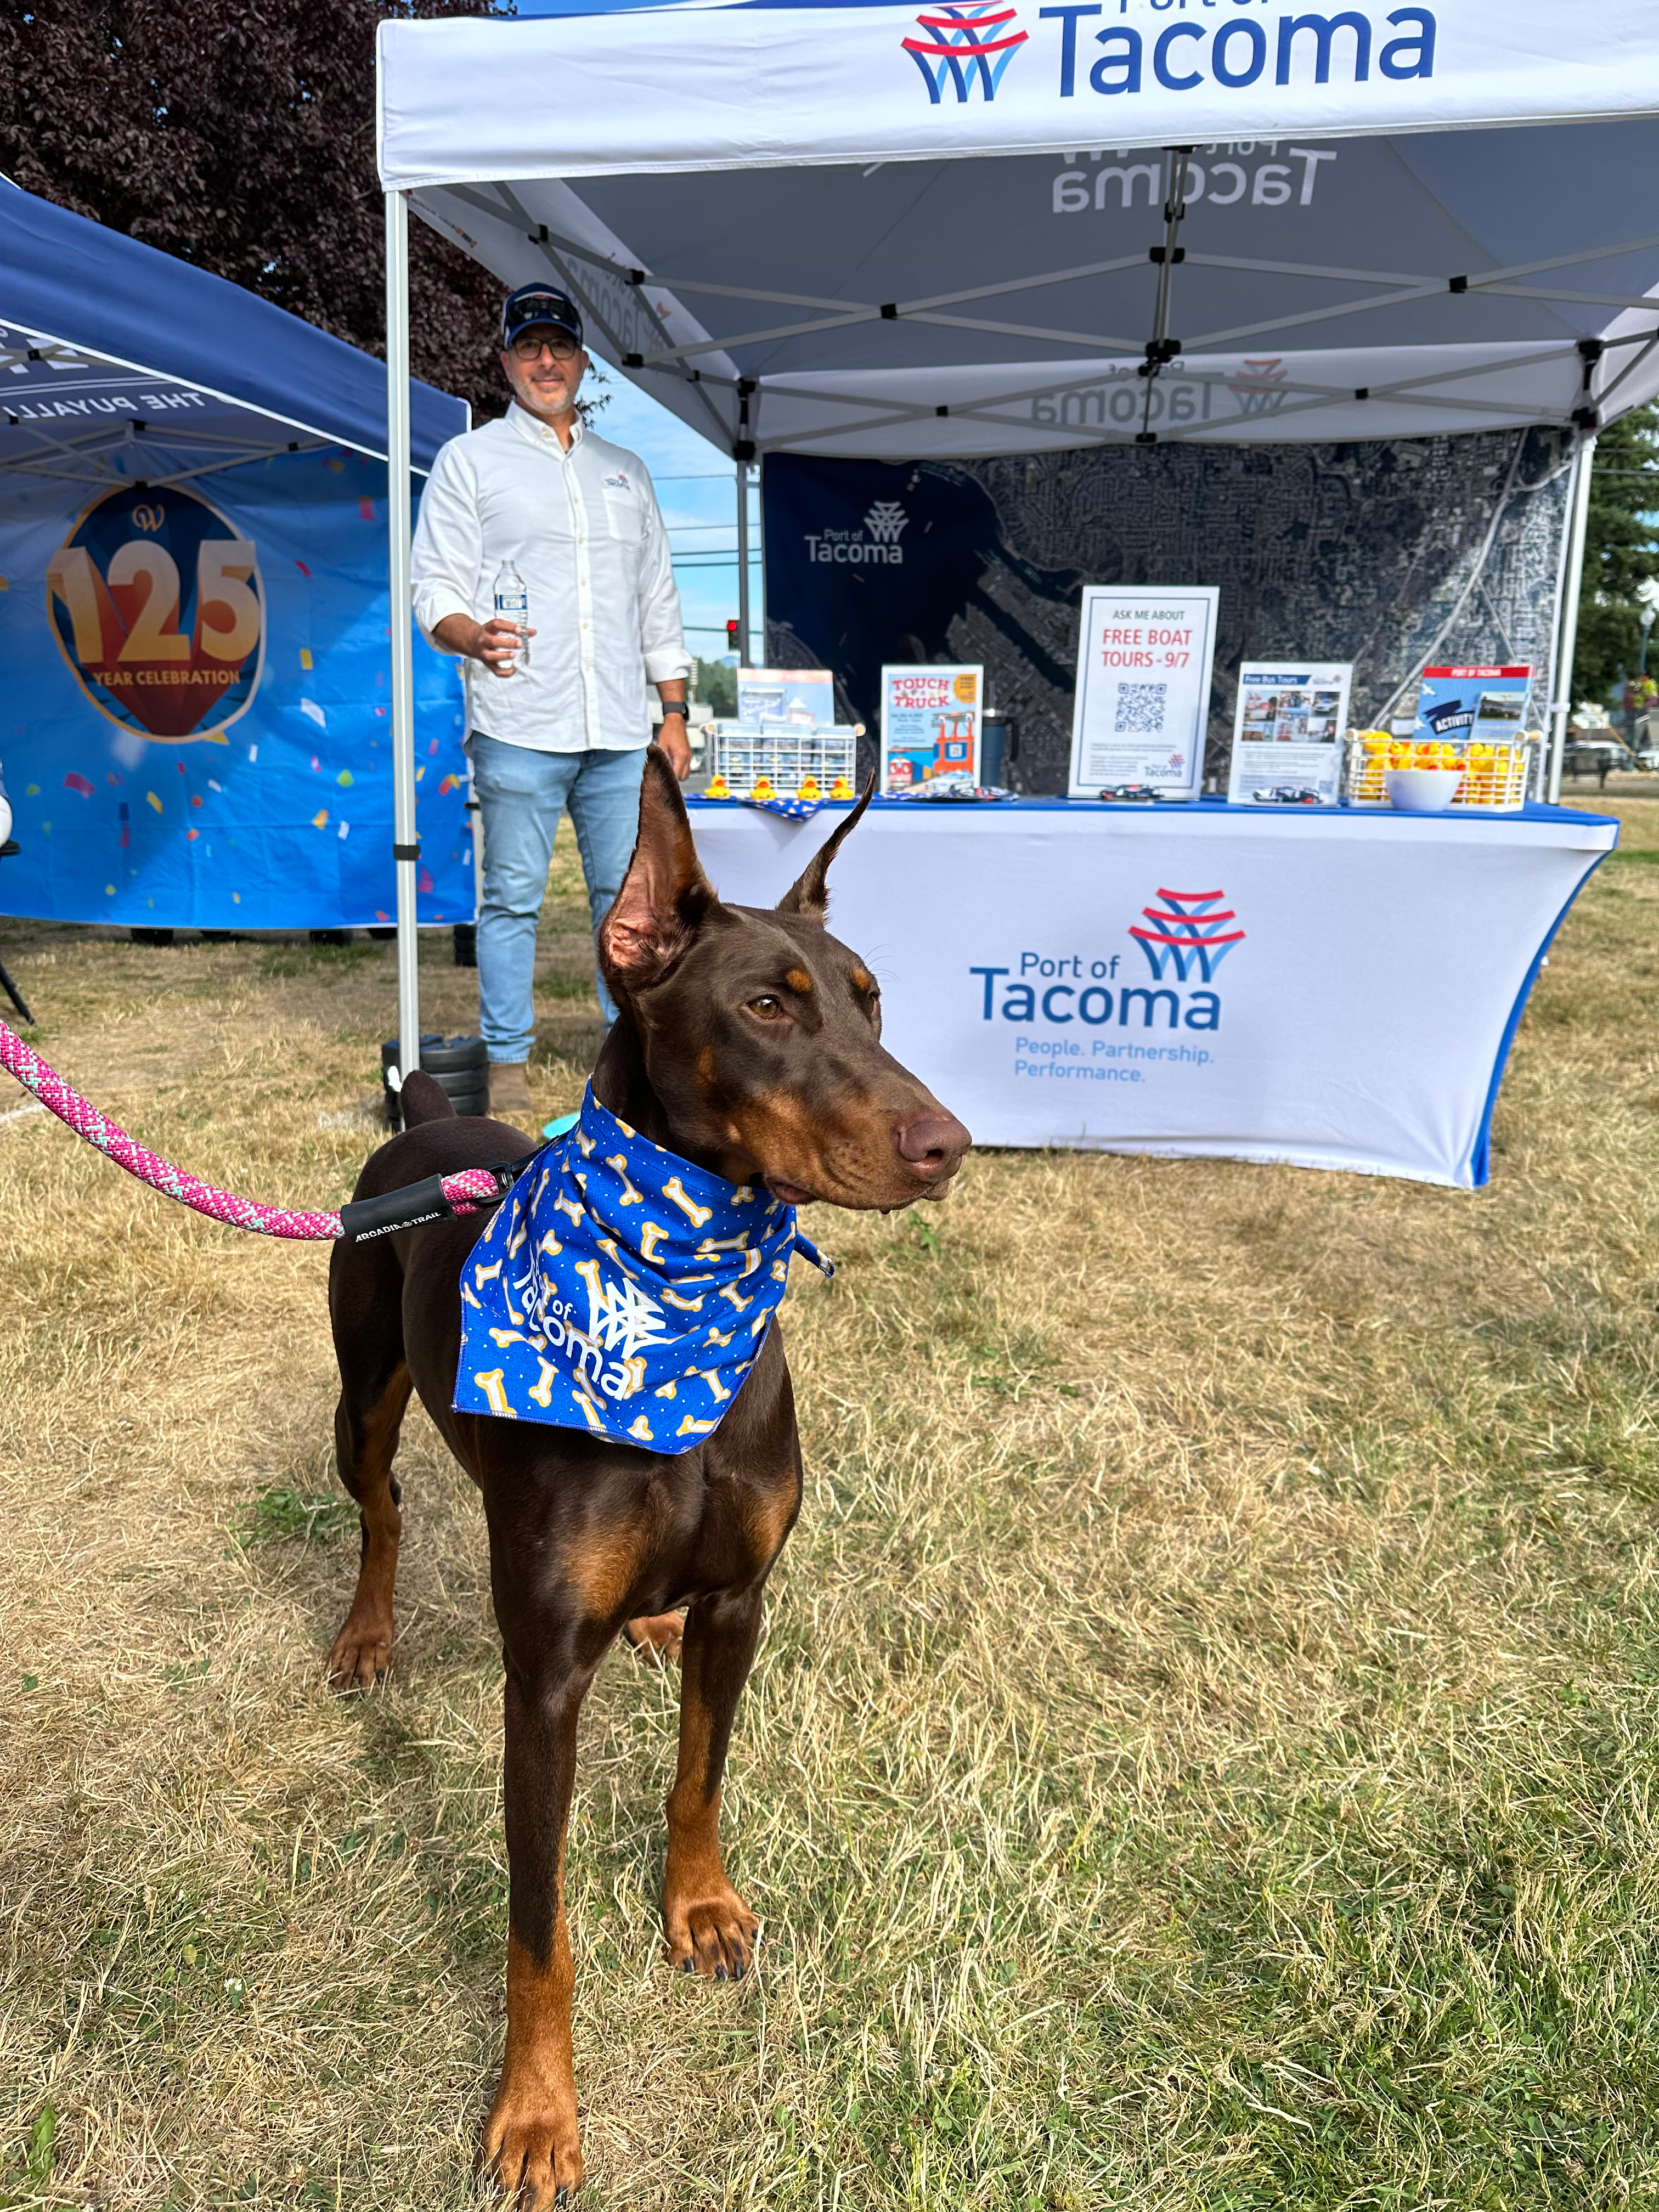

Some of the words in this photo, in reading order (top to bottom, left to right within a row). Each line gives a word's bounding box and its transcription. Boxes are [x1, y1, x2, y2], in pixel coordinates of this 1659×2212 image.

[1039, 4, 1437, 97] Tacoma
[823, 528, 850, 541] Port
[851, 529, 864, 541] of
[804, 535, 904, 564] Tacoma
[46, 540, 261, 664] 125
[1112, 610, 1132, 620] ASK
[1135, 610, 1150, 620] ME
[1151, 610, 1185, 620] ABOUT
[1102, 629, 1142, 645] FREE
[1148, 629, 1193, 646] BOAT
[93, 672, 134, 686] YEAR
[137, 669, 240, 685] CELEBRATION
[892, 677, 950, 691] TOUCH
[1245, 675, 1261, 684] Free
[1262, 675, 1276, 684] Bus
[1278, 675, 1298, 685] Tours
[894, 695, 951, 708] TRUCK
[1144, 766, 1182, 778] Tacoma
[1020, 952, 1082, 978] Port
[1091, 955, 1121, 979] of
[969, 967, 1221, 1031] Tacoma
[1015, 1036, 1085, 1058] People.
[1092, 1040, 1214, 1066] Partnership.
[1015, 1059, 1146, 1083] Performance.
[356, 1224, 403, 1243] ARCADIA
[410, 1211, 442, 1224] TRAIL
[552, 1299, 573, 1321] of
